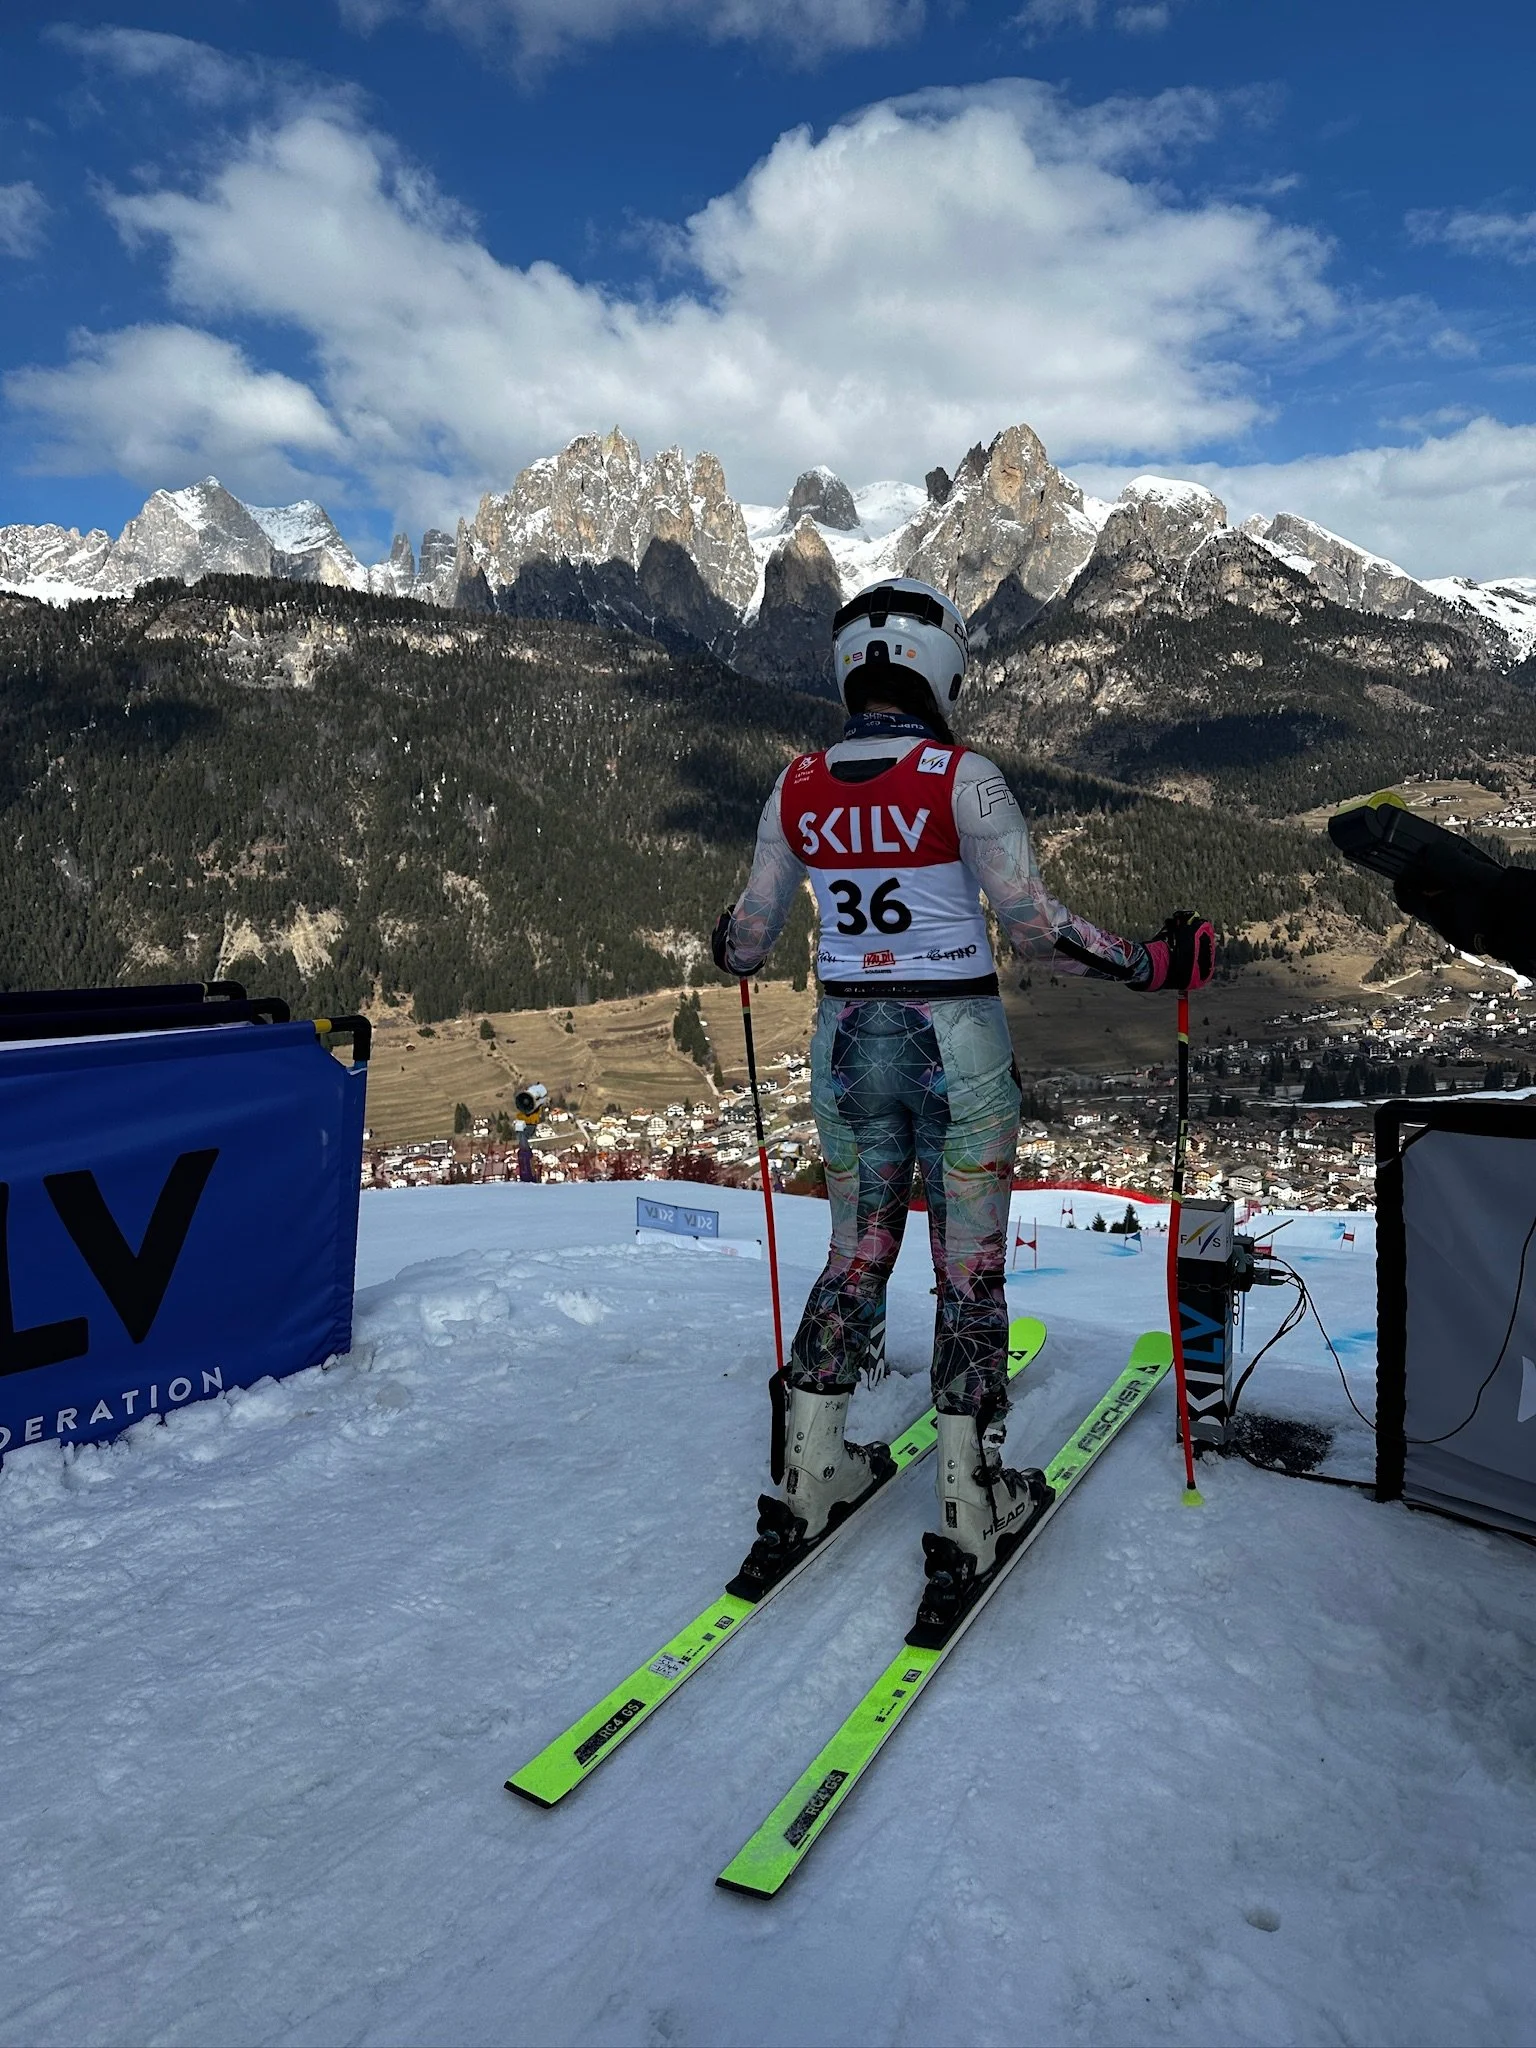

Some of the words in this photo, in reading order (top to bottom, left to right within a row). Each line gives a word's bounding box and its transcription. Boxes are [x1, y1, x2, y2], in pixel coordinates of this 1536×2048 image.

[798, 805, 930, 855] SKILV
[828, 877, 912, 936] 36
[1180, 1234, 1221, 1249] FIS
[1078, 1380, 1147, 1453] FISCHER
[983, 1502, 1025, 1540] HEAD
[599, 1718, 624, 1739] RC4
[621, 1703, 640, 1717] GS
[805, 1791, 829, 1816] RC4
[825, 1774, 844, 1790] GS
